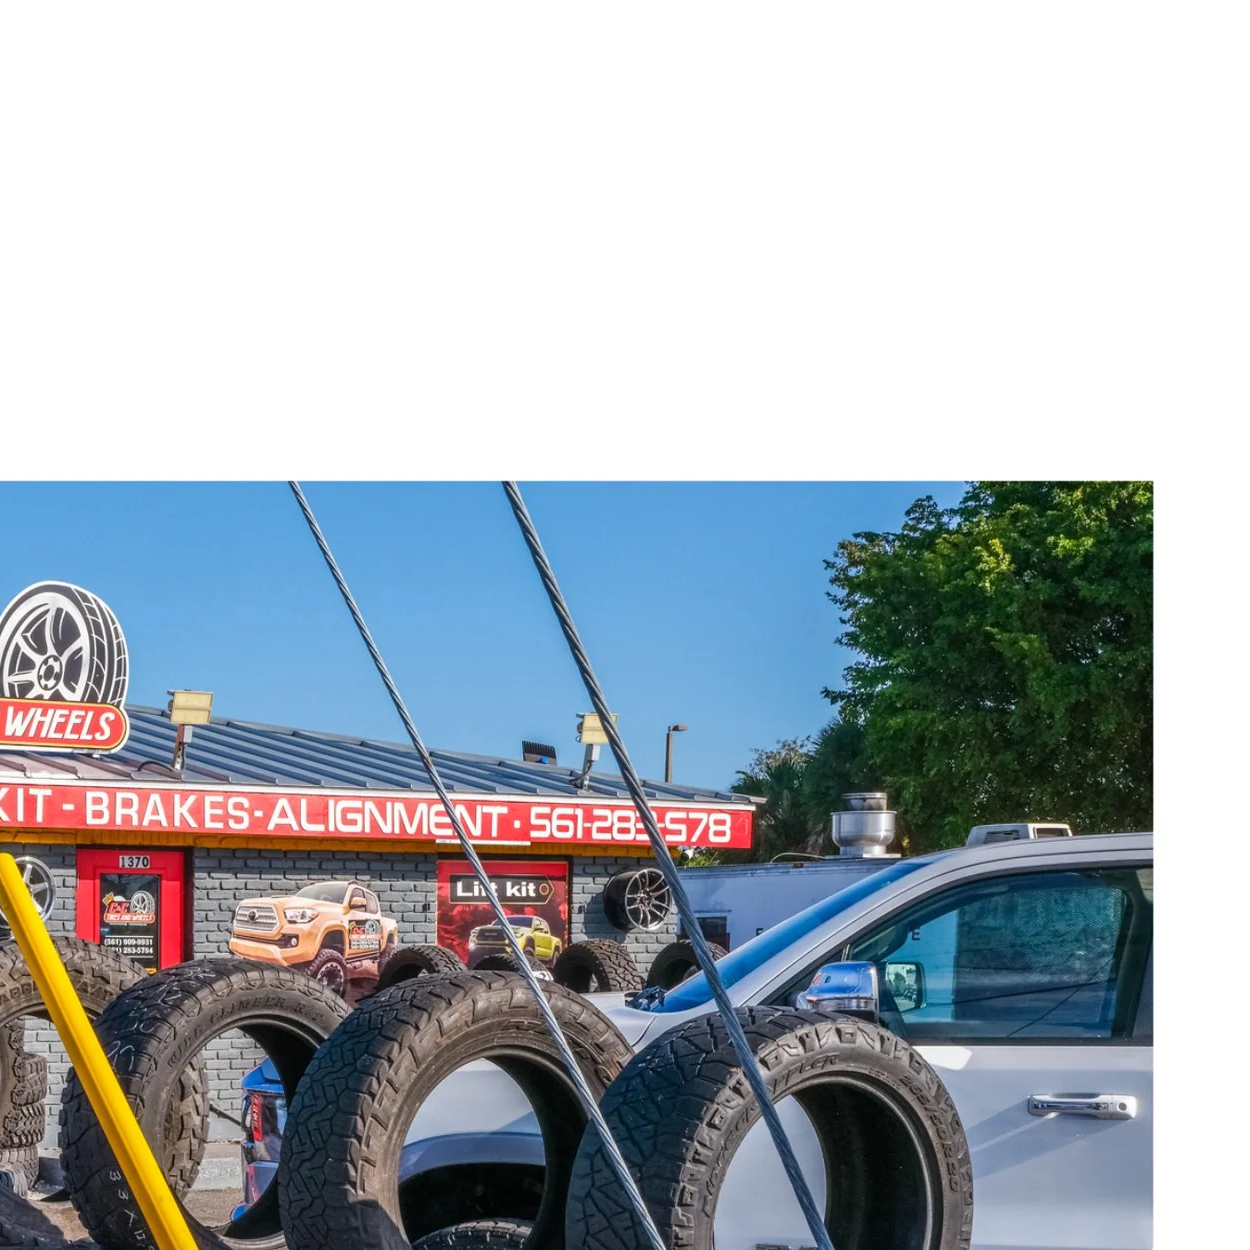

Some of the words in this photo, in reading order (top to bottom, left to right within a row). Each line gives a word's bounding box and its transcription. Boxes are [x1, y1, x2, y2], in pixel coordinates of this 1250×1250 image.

[4, 706, 117, 742] WHEELS
[120, 856, 149, 868] 1370
[505, 880, 537, 898] kit
